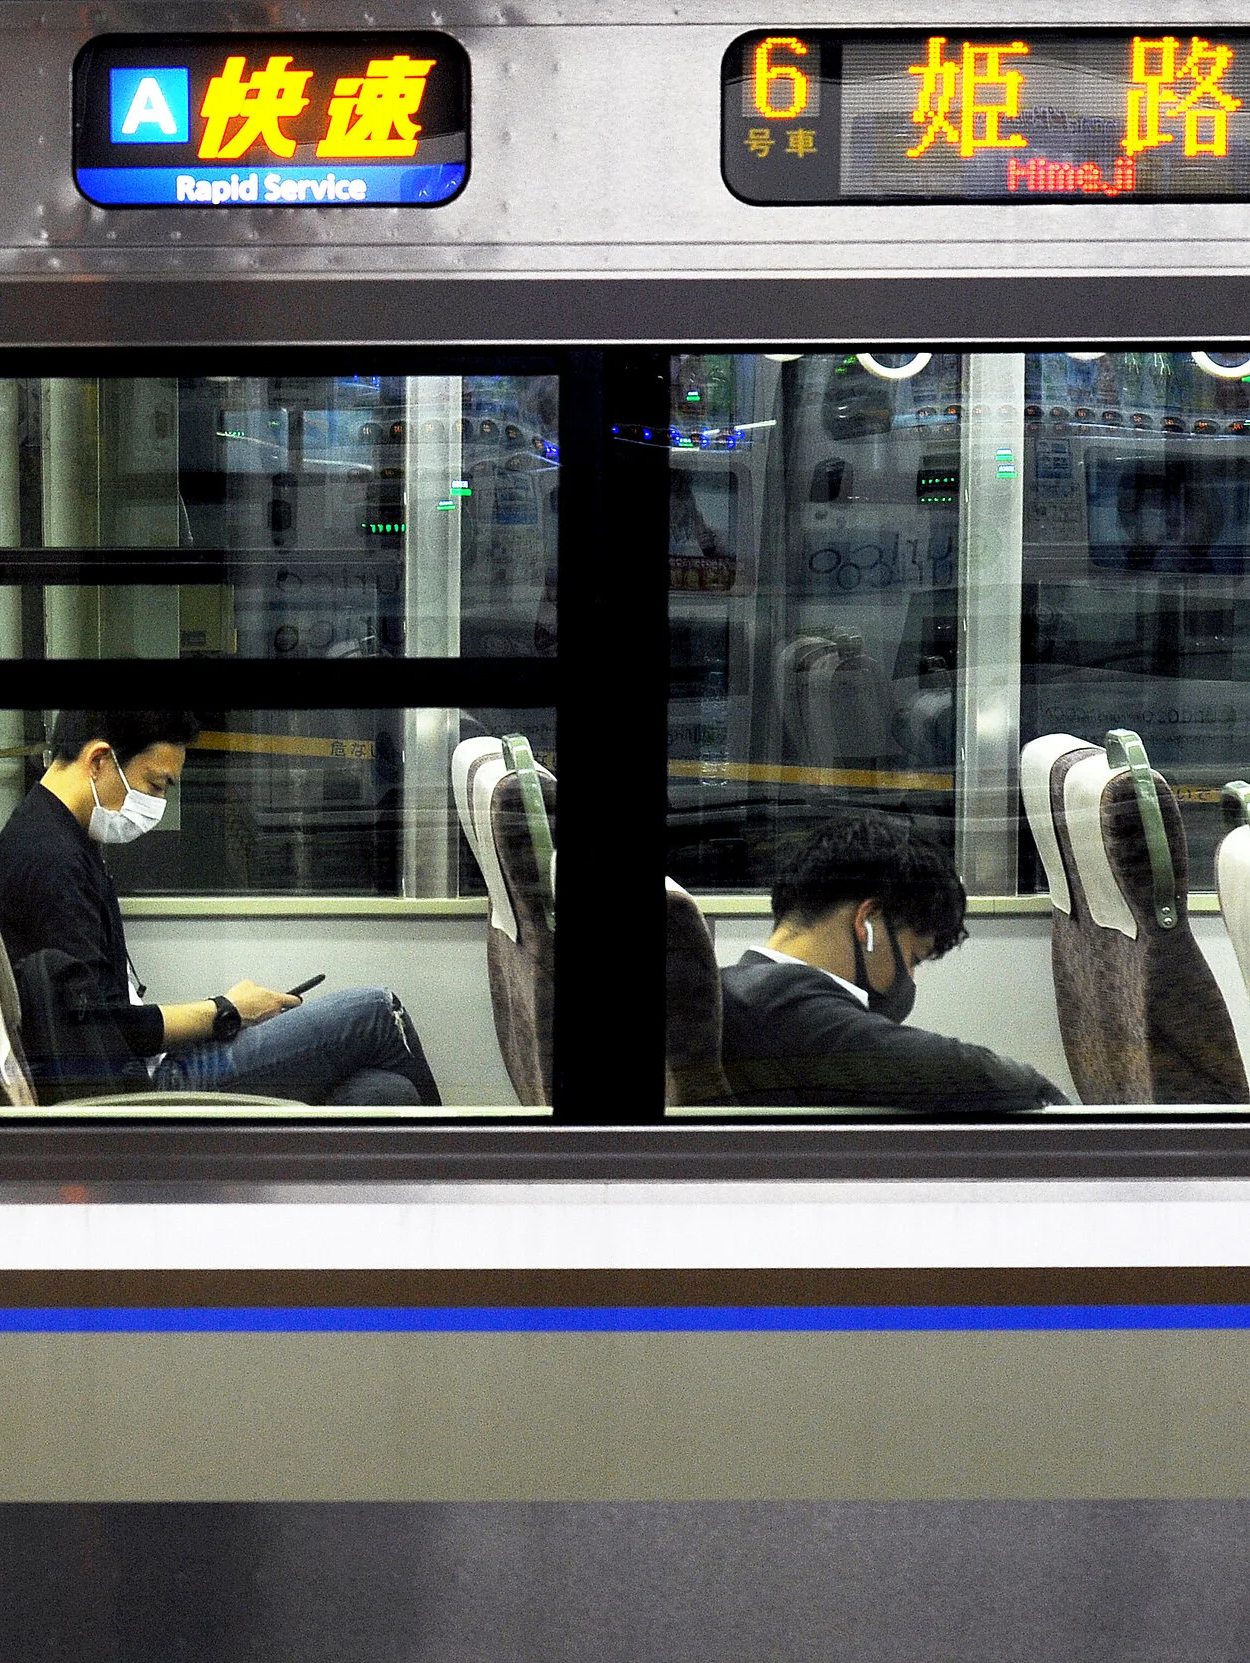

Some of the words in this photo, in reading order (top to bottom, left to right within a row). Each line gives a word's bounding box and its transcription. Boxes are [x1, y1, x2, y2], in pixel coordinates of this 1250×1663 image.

[121, 77, 178, 135] A
[197, 55, 437, 159] 快速
[755, 37, 807, 119] 6
[907, 37, 1243, 158] 姫路
[744, 128, 817, 158] 号車
[176, 174, 258, 204] Rapid
[263, 174, 367, 200] Service
[1008, 157, 1136, 196] Himeji
